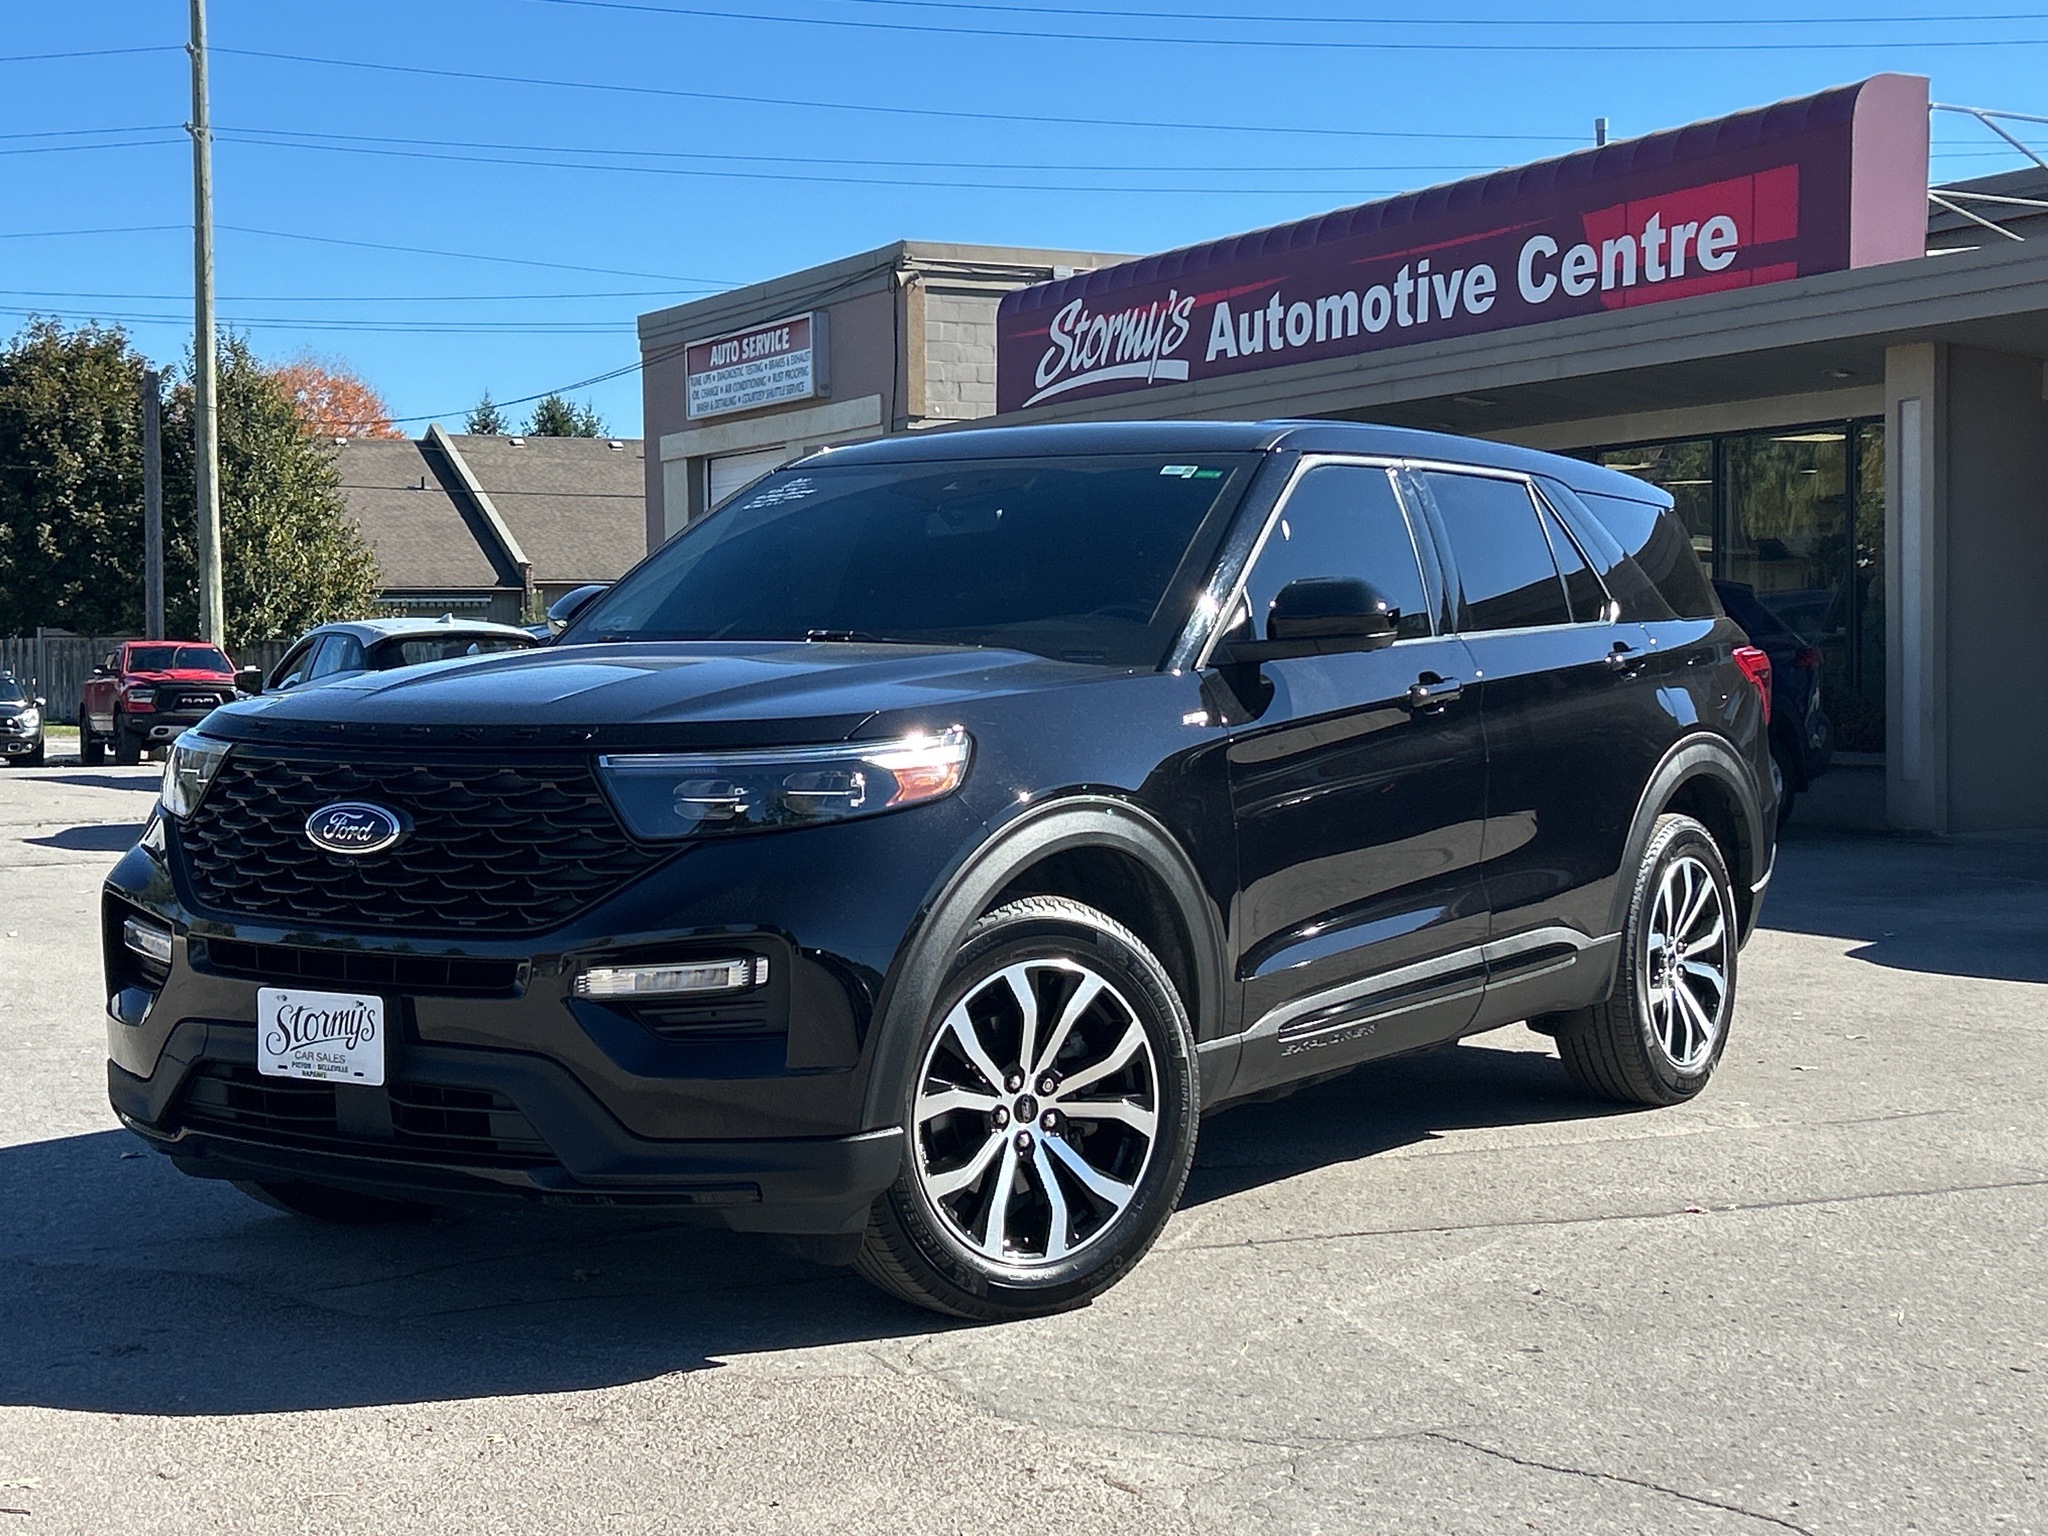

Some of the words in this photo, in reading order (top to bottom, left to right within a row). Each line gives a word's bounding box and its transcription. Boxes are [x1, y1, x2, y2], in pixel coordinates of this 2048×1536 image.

[1034, 289, 1196, 385] Stormy's
[1205, 259, 1497, 362] Automotive
[1517, 210, 1739, 304] Centre
[710, 340, 739, 367] AUTO
[742, 327, 790, 360] SERVICE
[323, 811, 376, 842] Ford
[265, 1003, 377, 1056] Stormy's
[294, 1050, 315, 1061] CAR
[316, 1051, 347, 1065] SALES
